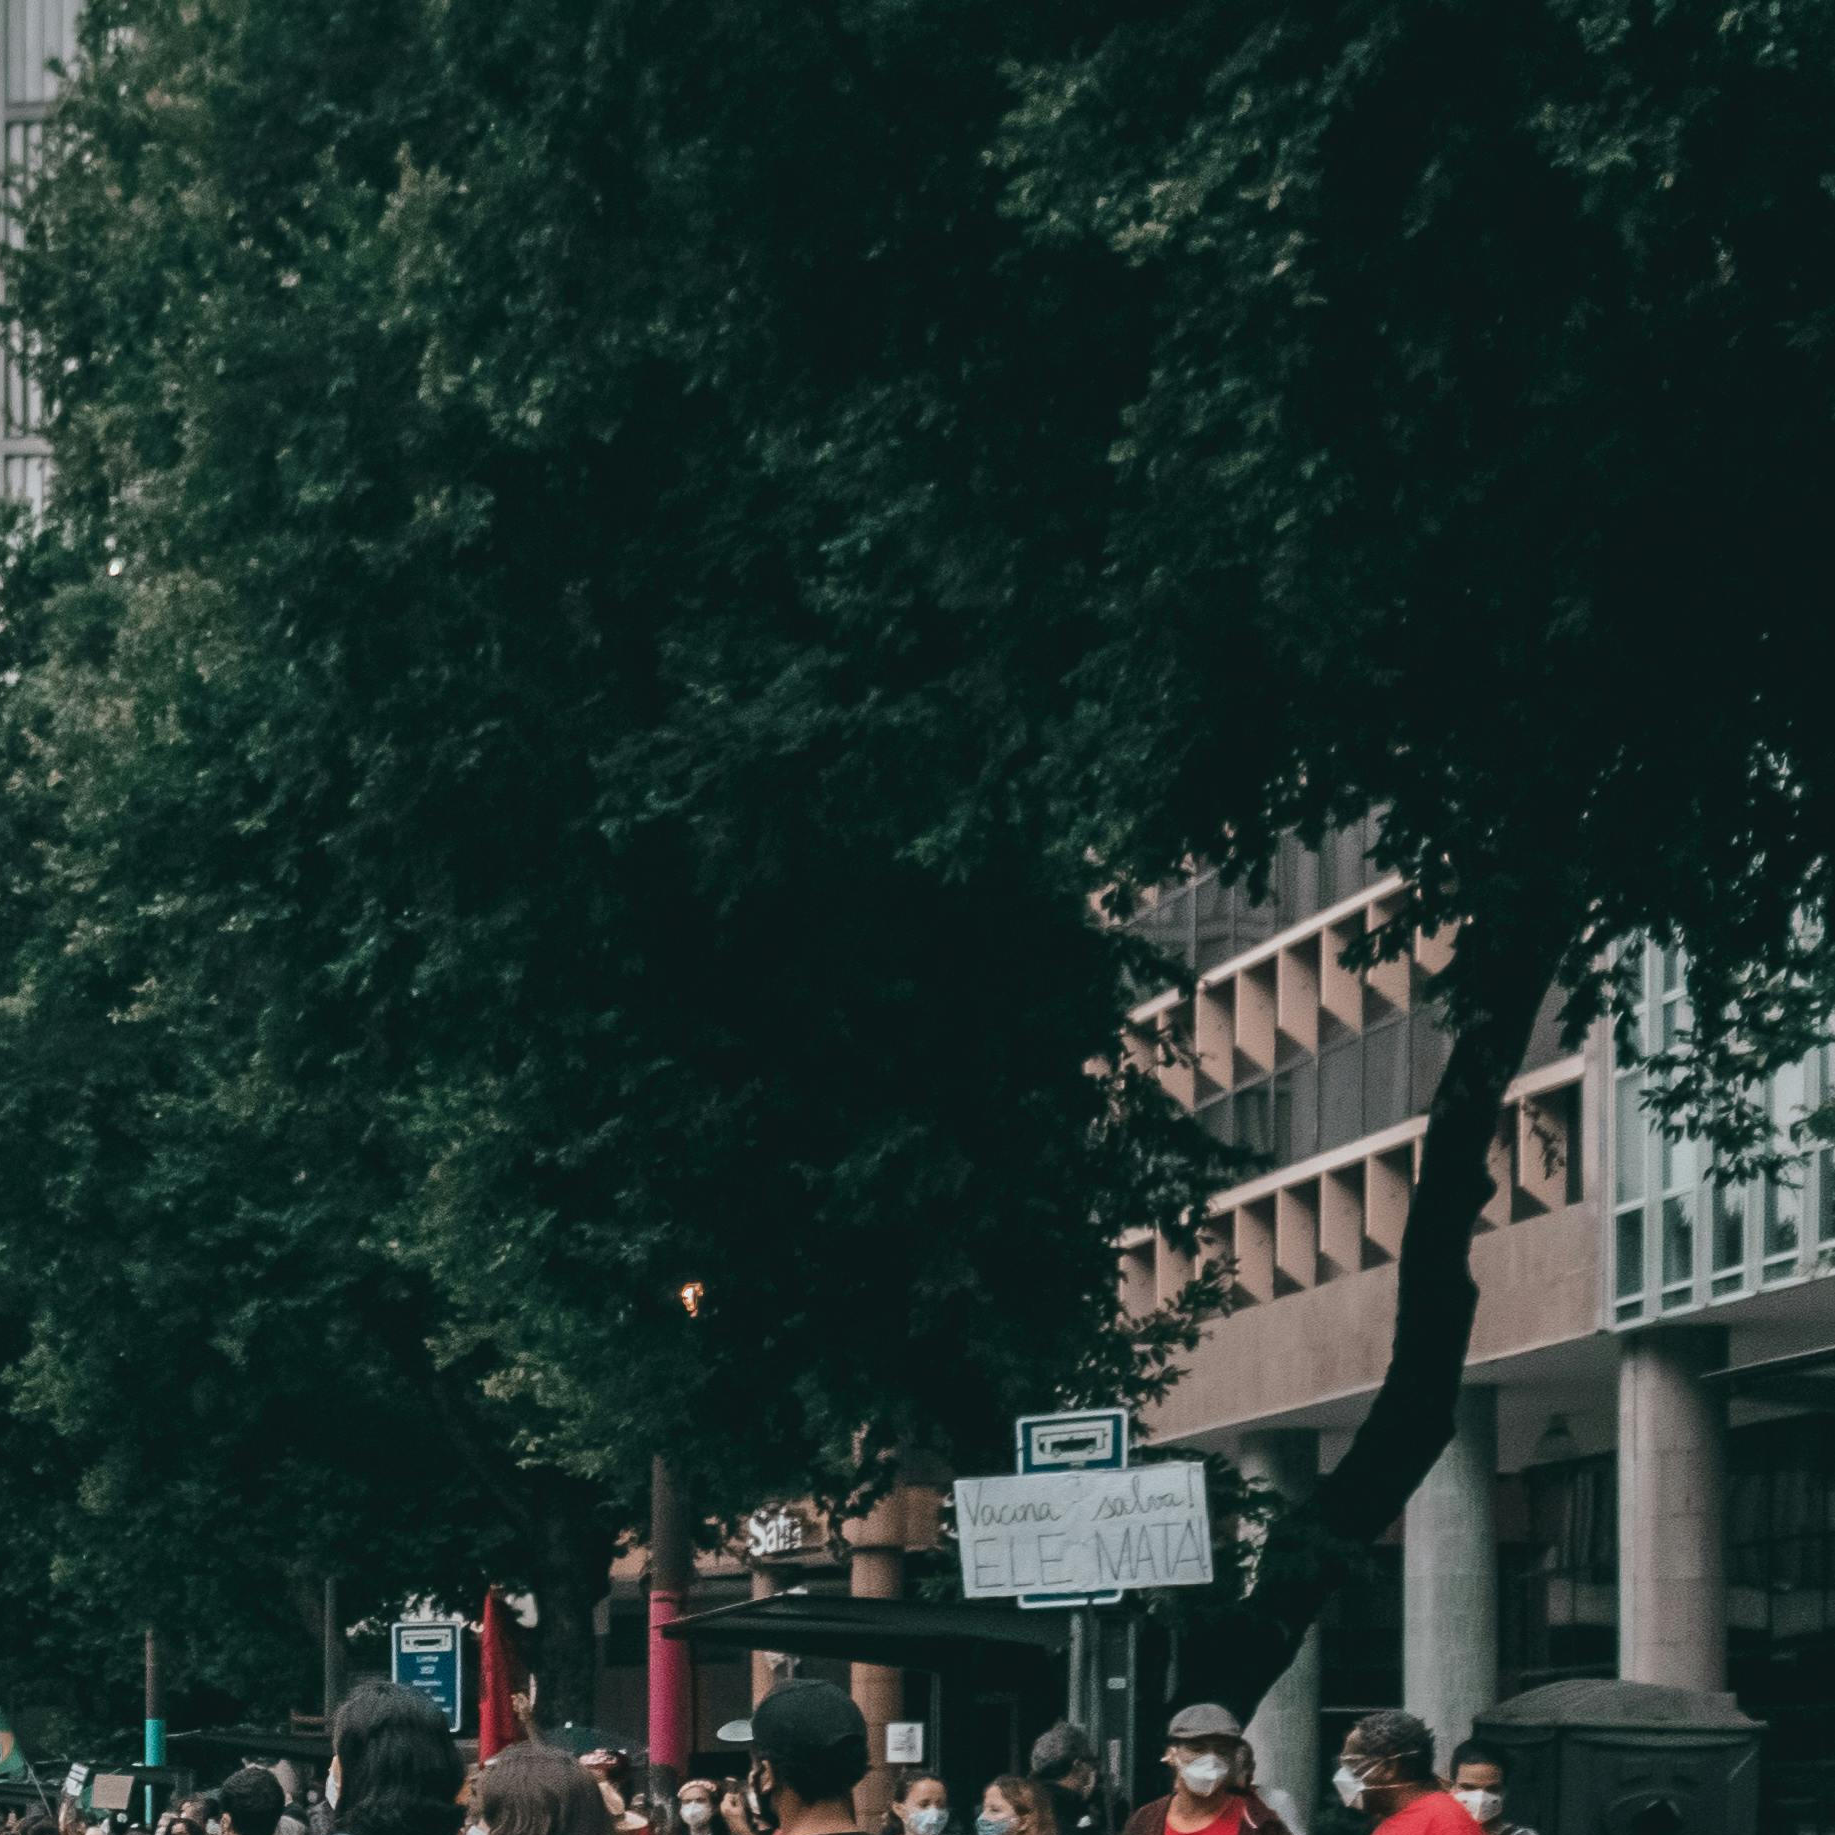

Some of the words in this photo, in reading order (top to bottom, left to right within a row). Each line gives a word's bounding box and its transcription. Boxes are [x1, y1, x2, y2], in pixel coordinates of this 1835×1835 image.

[1091, 1468, 1195, 1522] salva!
[973, 1531, 1073, 1589] ELE
[1094, 1515, 1208, 1584] MATA!
